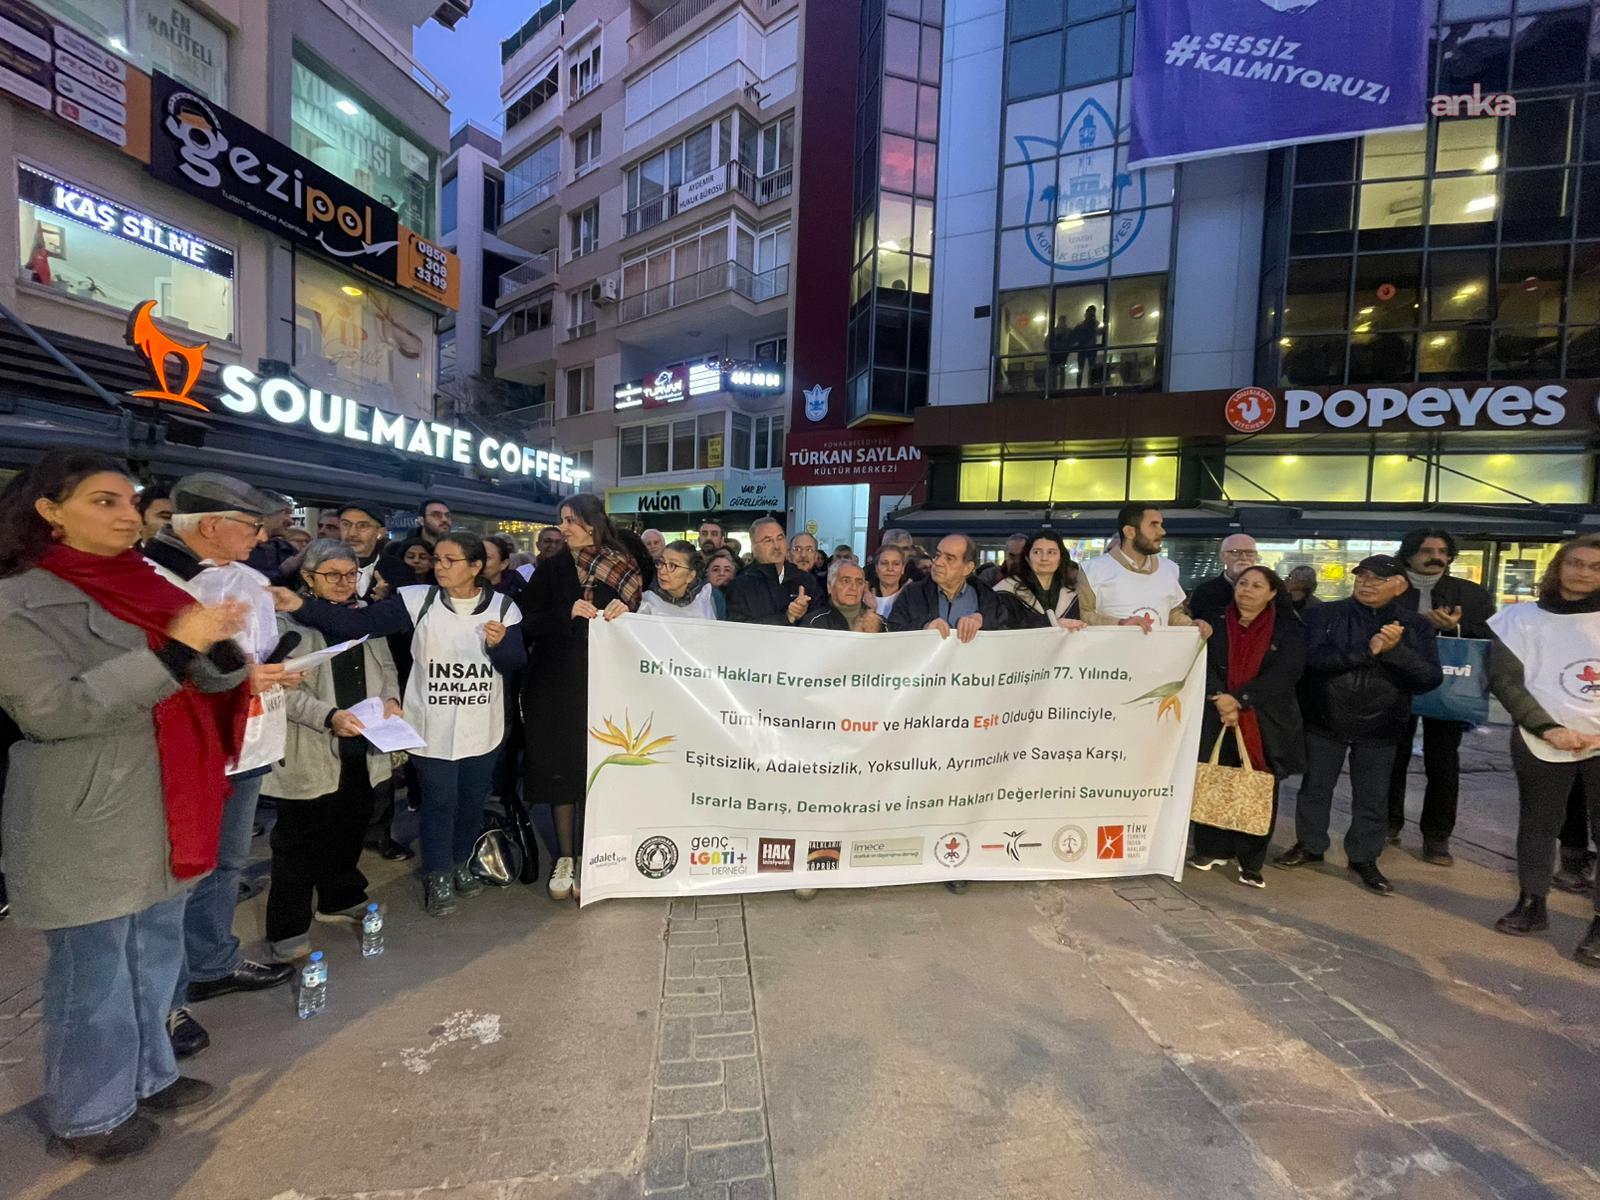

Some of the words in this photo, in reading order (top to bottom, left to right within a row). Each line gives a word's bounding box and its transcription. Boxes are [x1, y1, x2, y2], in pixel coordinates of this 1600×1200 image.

[165, 100, 373, 243] gezipol
[55, 186, 117, 231] KAŞ
[123, 211, 207, 263] SİLME
[417, 240, 448, 264] 0850
[425, 257, 448, 277] 308
[220, 363, 473, 465] SOULMATE
[478, 437, 574, 483] COFFEE
[789, 448, 853, 466] TÜRKAN
[856, 446, 921, 462] SAYLAN
[814, 466, 851, 475] KÜLTÜR
[853, 463, 898, 474] MERKEZİ
[638, 491, 681, 511] mion
[428, 658, 494, 678] İNSAN
[640, 659, 664, 675] BM
[668, 658, 712, 679] İnsan
[717, 664, 773, 685] Hakları
[776, 671, 847, 688] Evrensel
[851, 672, 946, 691] Bildirgesinin
[951, 673, 995, 688] Kabul
[998, 668, 1050, 686] Edilişinin
[1053, 666, 1073, 680] 77.
[1078, 666, 1132, 682] Yılında,
[1442, 664, 1472, 677] avi
[428, 682, 492, 692] HAKLARI
[720, 709, 753, 727] Tüm
[757, 708, 836, 731] İnsanların
[841, 718, 879, 732] Onur
[883, 720, 900, 732] ve
[904, 715, 970, 730] Haklarda
[974, 713, 999, 731] Eşit
[1002, 707, 1043, 725] Olduğu
[1047, 706, 1116, 723] Bilinciyle,
[686, 751, 761, 773] Eşitsizlik,
[766, 759, 862, 775] Adaletsizlik,
[868, 757, 942, 774] Yoksulluk,
[946, 749, 1010, 772] Ayrımcılık
[1013, 751, 1027, 760] ve
[1031, 747, 1082, 763] Savaşa
[1086, 746, 1127, 763] Karşı,
[691, 791, 742, 810] Israrla
[747, 797, 792, 814] Barış,
[797, 800, 880, 814] Demokrasi
[885, 802, 901, 812] ve
[905, 795, 943, 810] İnsan
[948, 791, 994, 808] Hakları
[997, 786, 1076, 803] Değerlerini
[1080, 784, 1174, 802] Savunuyoruz!
[1127, 822, 1147, 833] TİHV
[691, 835, 729, 851] genç
[762, 843, 791, 860] HAK
